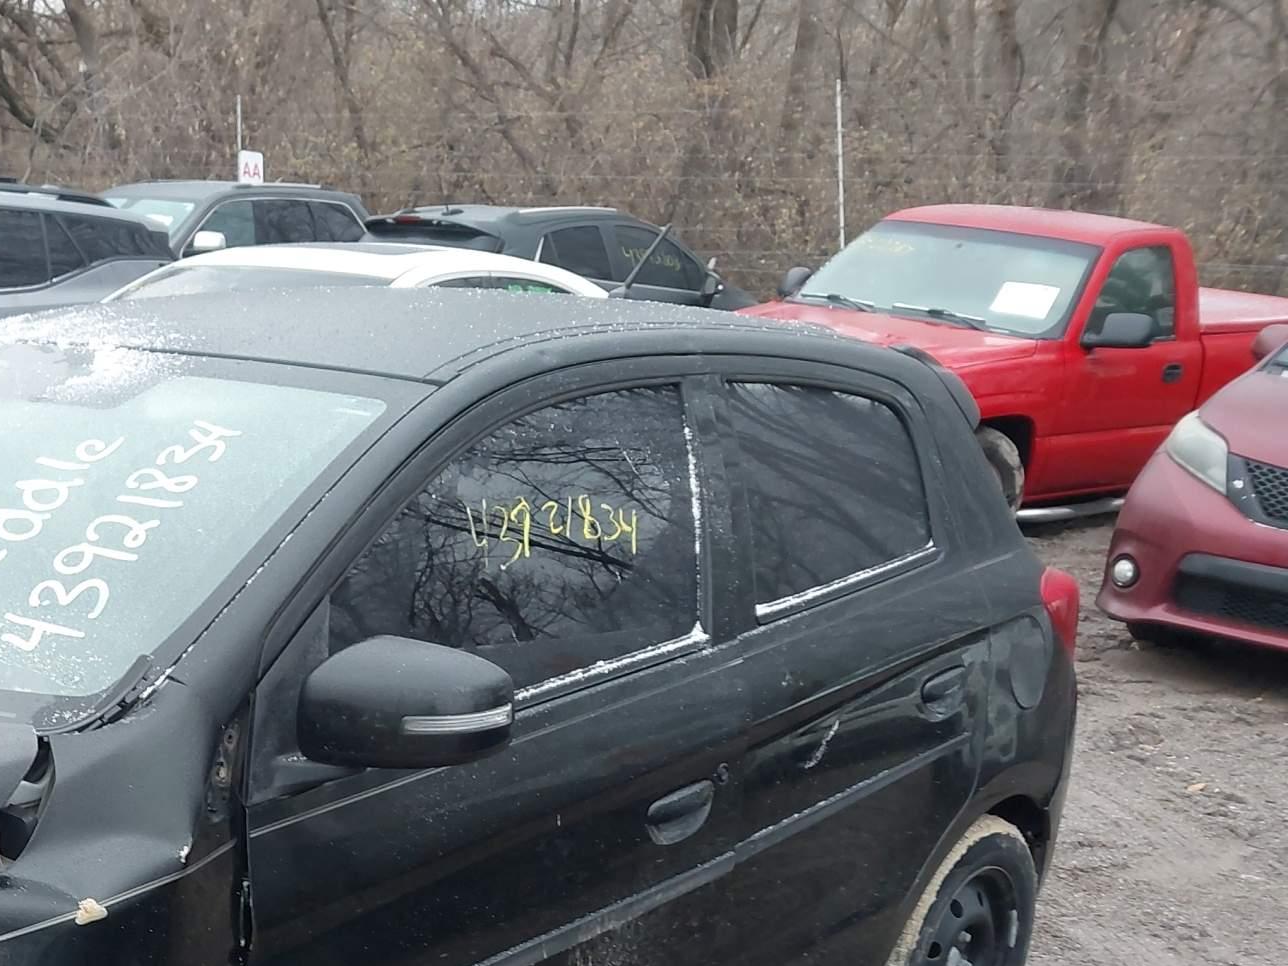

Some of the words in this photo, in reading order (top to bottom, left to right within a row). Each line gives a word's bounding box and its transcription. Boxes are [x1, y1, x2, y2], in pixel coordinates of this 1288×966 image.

[242, 161, 262, 180] AA
[0, 420, 243, 652] 43921834
[466, 495, 638, 570] 43921834
